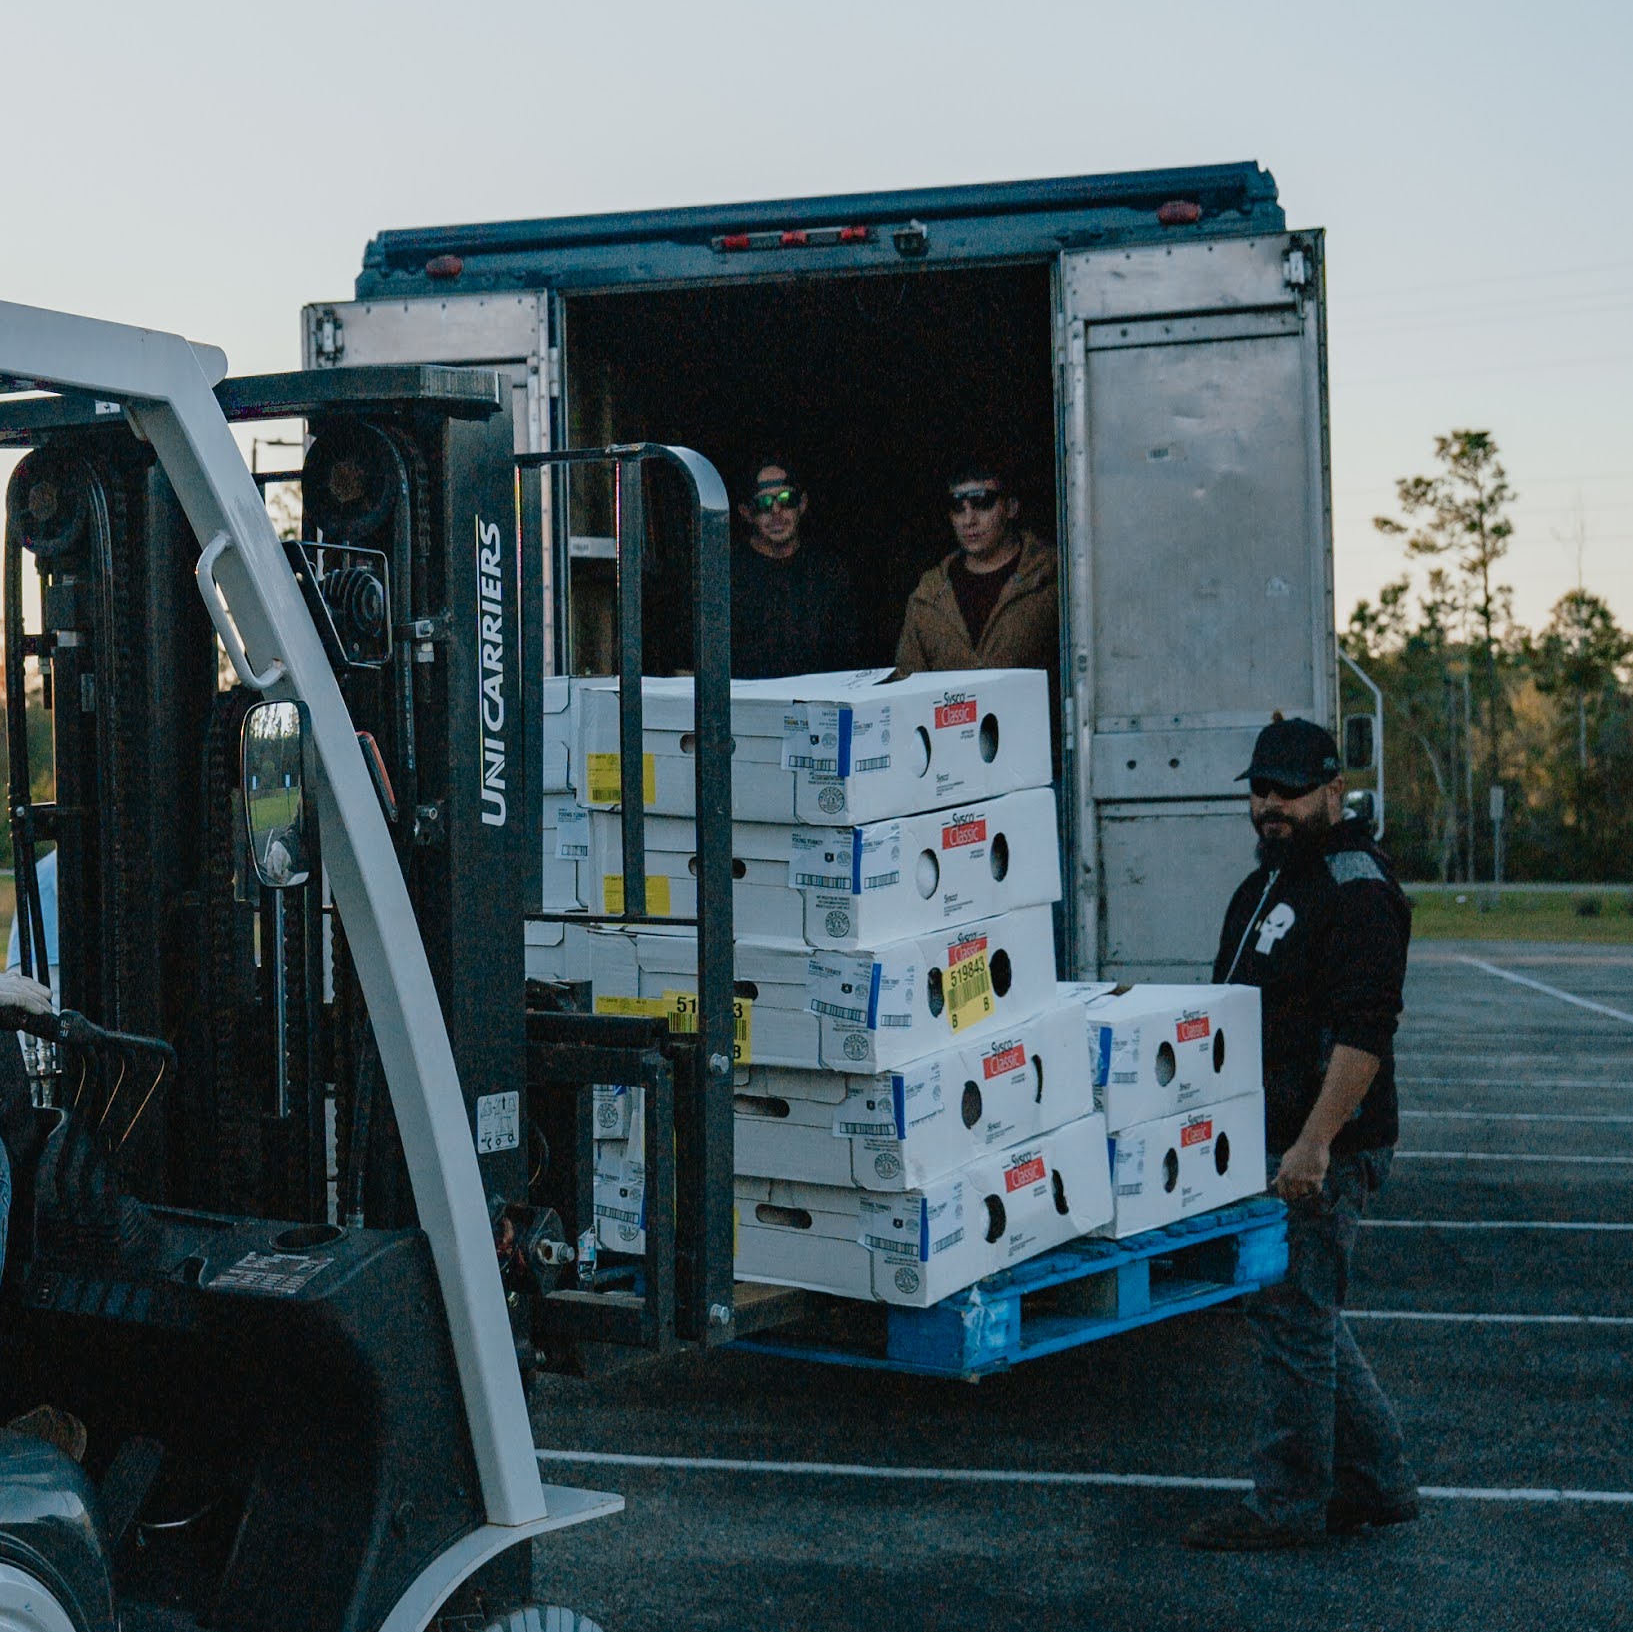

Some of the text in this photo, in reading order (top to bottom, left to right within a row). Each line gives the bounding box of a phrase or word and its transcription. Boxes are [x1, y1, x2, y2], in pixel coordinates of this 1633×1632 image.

[943, 692, 966, 707] Sysco
[941, 705, 971, 725] Classic
[952, 812, 975, 827] Sysco
[949, 825, 979, 846] Classic
[957, 932, 977, 944] Sysco
[954, 941, 981, 962] Classic
[950, 956, 985, 987] 519843
[984, 997, 990, 1012] B
[952, 1014, 958, 1028] B
[991, 1040, 1014, 1056] Sysco
[990, 1052, 1020, 1075] Classic
[1011, 1151, 1032, 1168] Sysco
[1011, 1163, 1041, 1187] Classic
